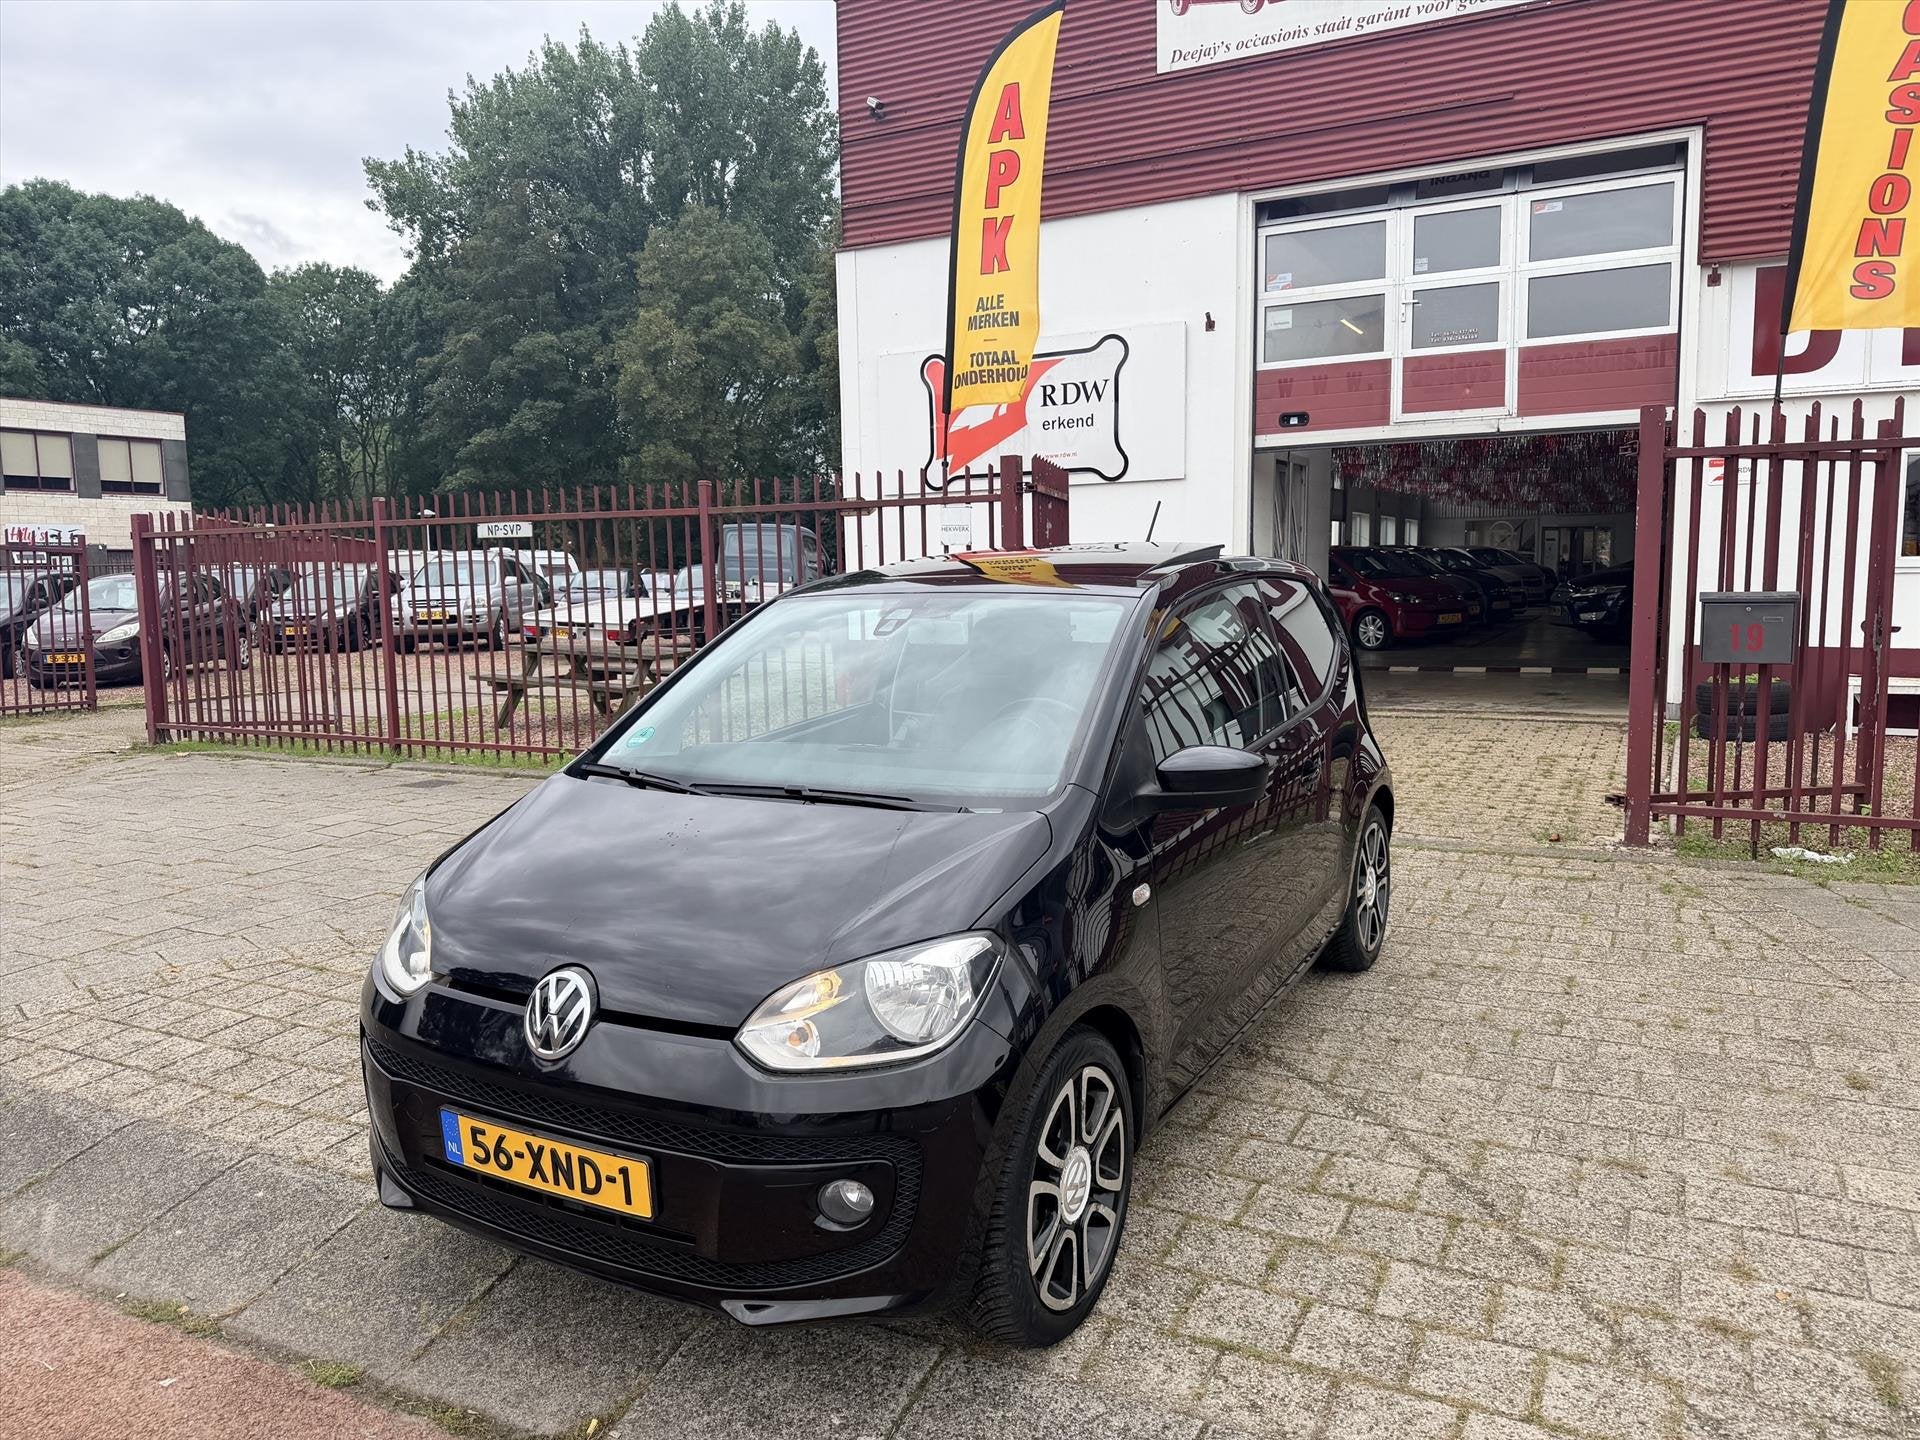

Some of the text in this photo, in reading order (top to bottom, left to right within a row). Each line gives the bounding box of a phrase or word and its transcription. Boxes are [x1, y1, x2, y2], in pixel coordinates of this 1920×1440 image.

[1171, 40, 1232, 63] Deejay's
[1236, 25, 1310, 51] occasions
[1355, 5, 1412, 31] garant
[980, 82, 1026, 275] APK
[976, 294, 1005, 313] ALLE
[967, 311, 1020, 332] MERKEN
[970, 350, 1020, 368] TOTAAL
[1040, 379, 1110, 407] RDW
[1042, 414, 1095, 430] erkend
[487, 523, 522, 536] NP-SVP
[1729, 623, 1765, 652] 19
[447, 1126, 632, 1206] NL 56-XND-1
